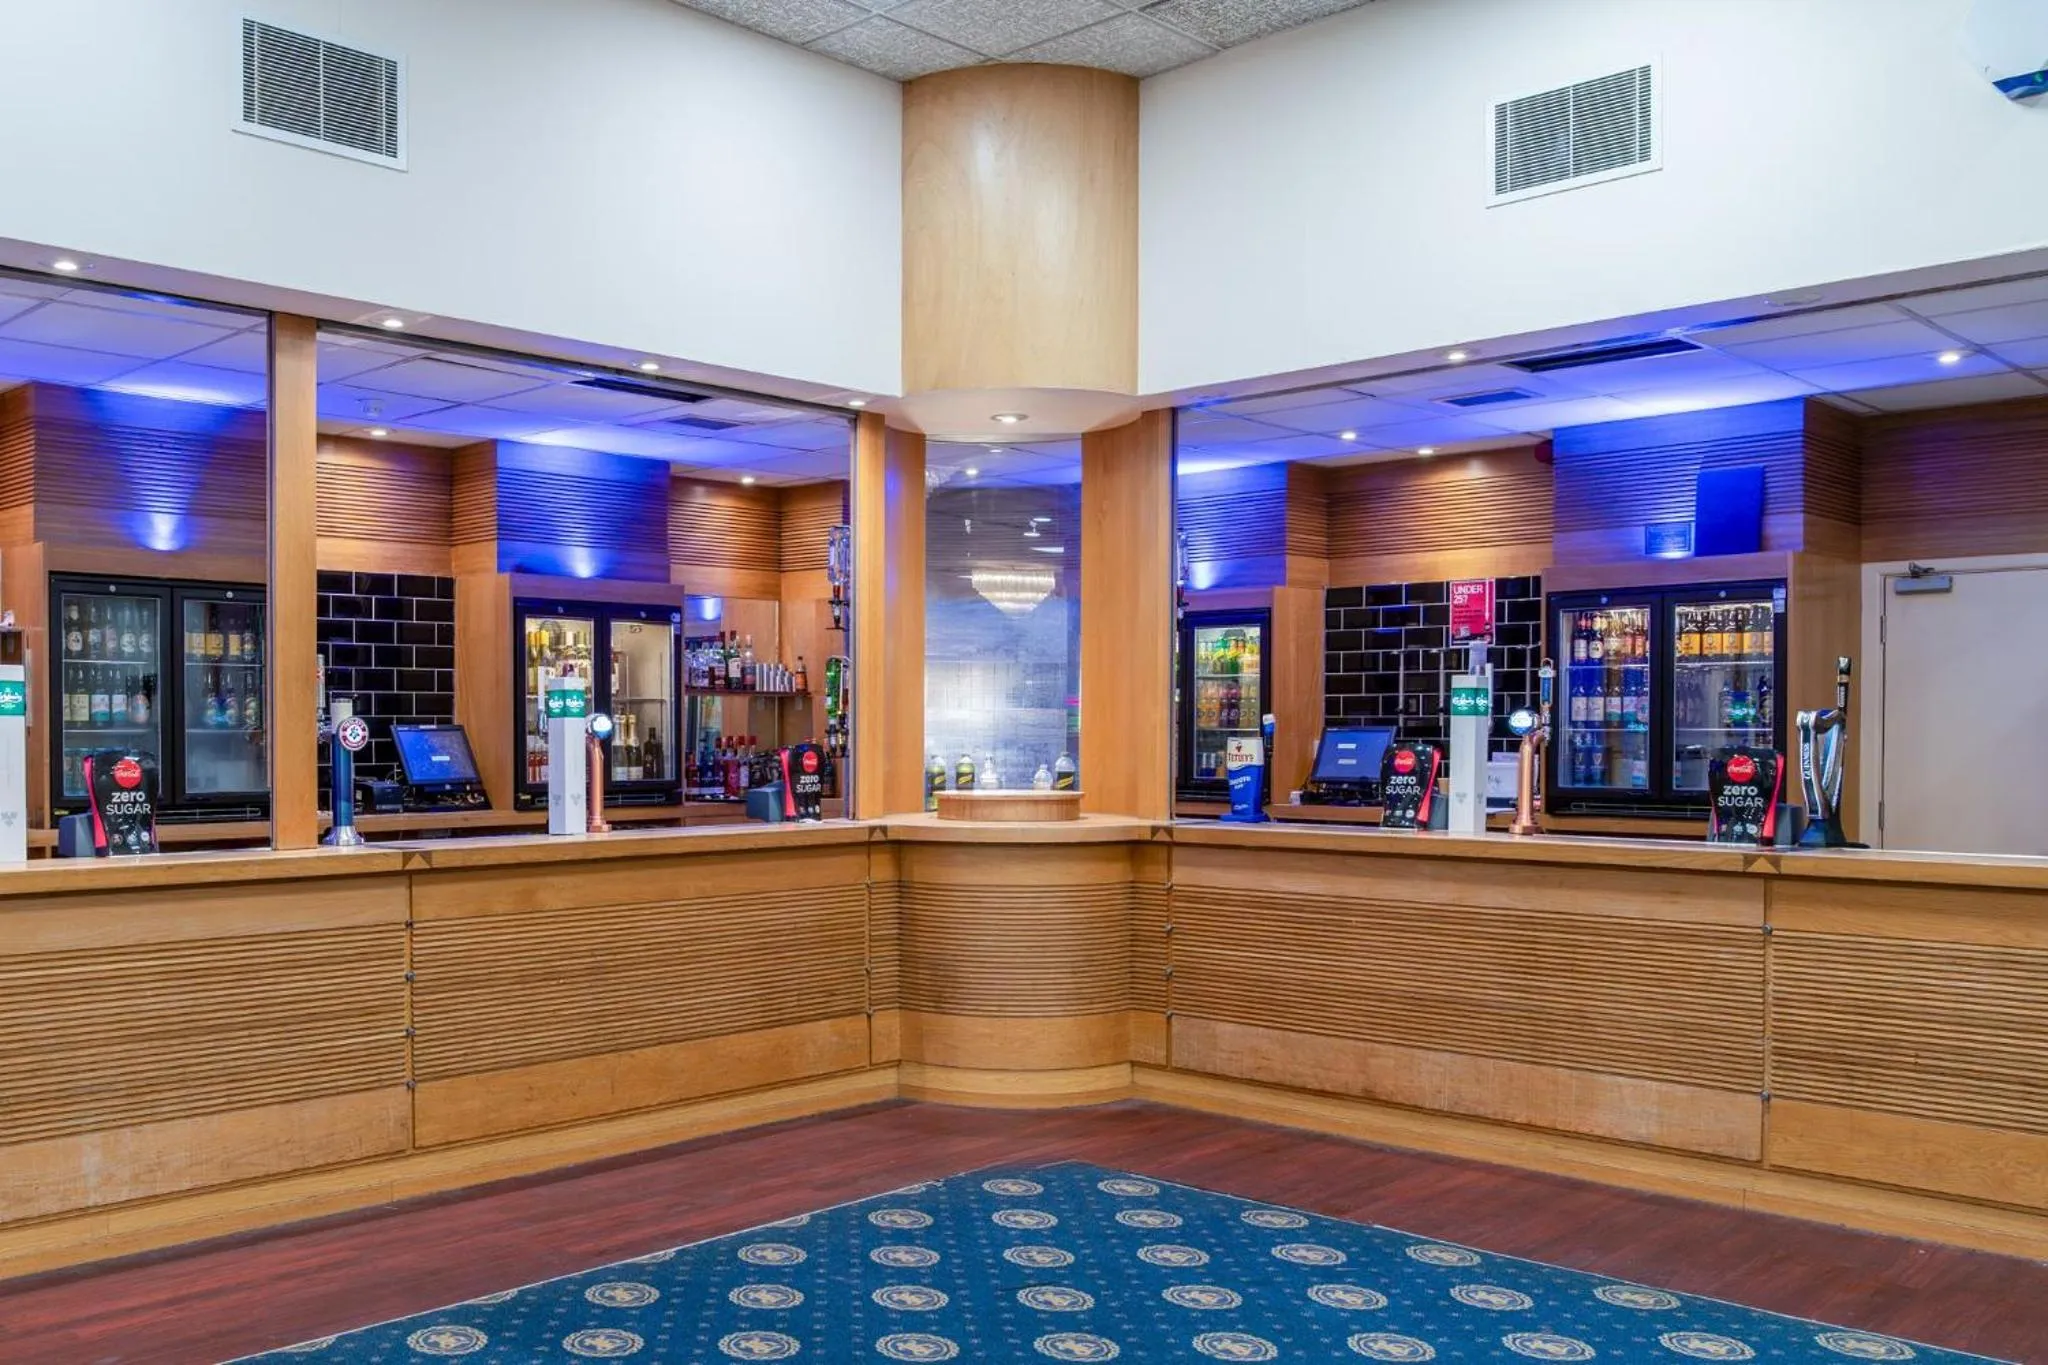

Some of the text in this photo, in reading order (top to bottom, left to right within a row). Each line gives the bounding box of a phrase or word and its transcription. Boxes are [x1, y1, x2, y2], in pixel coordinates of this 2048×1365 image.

[1453, 584, 1484, 594] UNDER
[1390, 775, 1417, 786] zero
[1385, 785, 1421, 796] SUGAR
[1723, 785, 1758, 796] zero
[111, 791, 146, 803] zero
[1717, 796, 1764, 808] SUGAR
[105, 803, 152, 815] SUGAR
